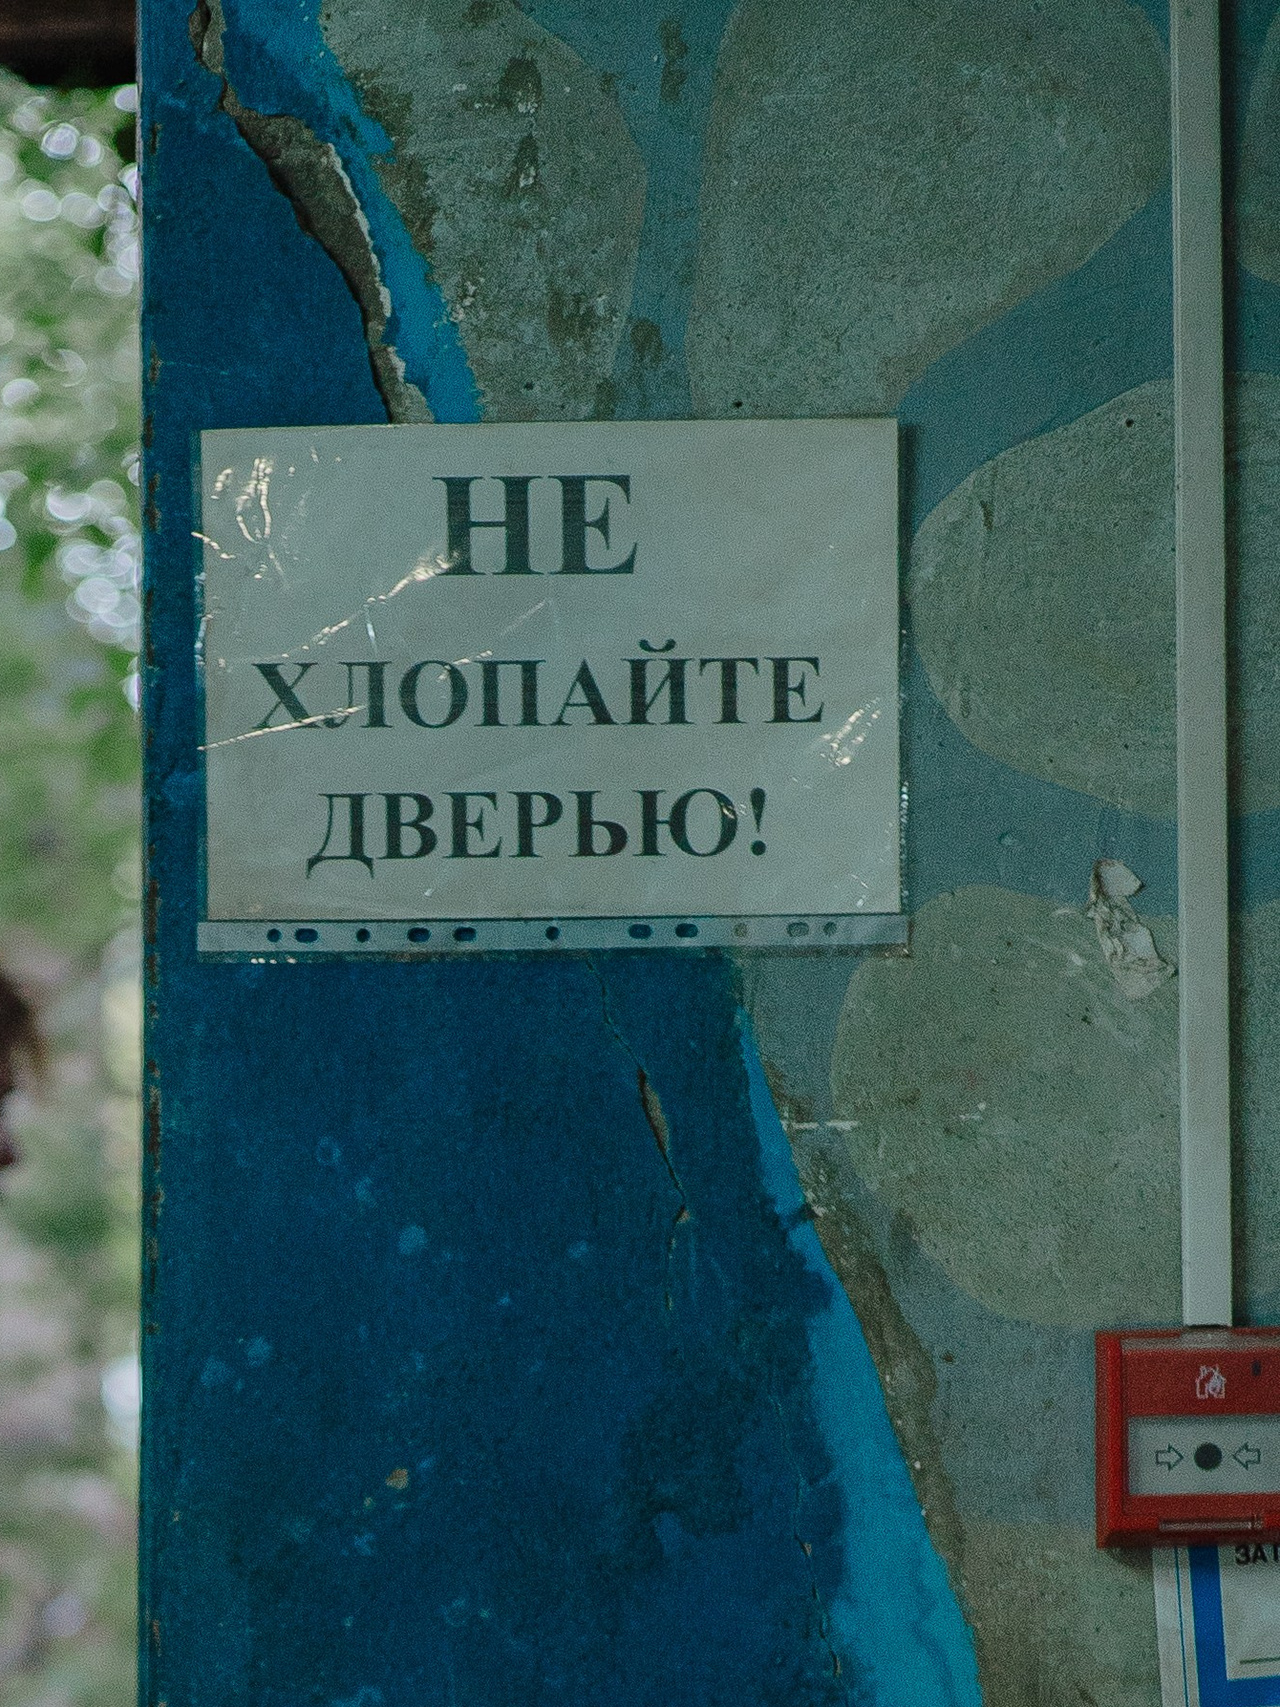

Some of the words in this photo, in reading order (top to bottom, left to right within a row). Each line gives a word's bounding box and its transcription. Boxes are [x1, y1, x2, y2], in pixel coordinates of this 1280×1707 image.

[432, 474, 638, 577] НЕ
[251, 639, 824, 729] ХЛОПАЙТЕ
[306, 787, 768, 879] ДВЕРЬЮ!
